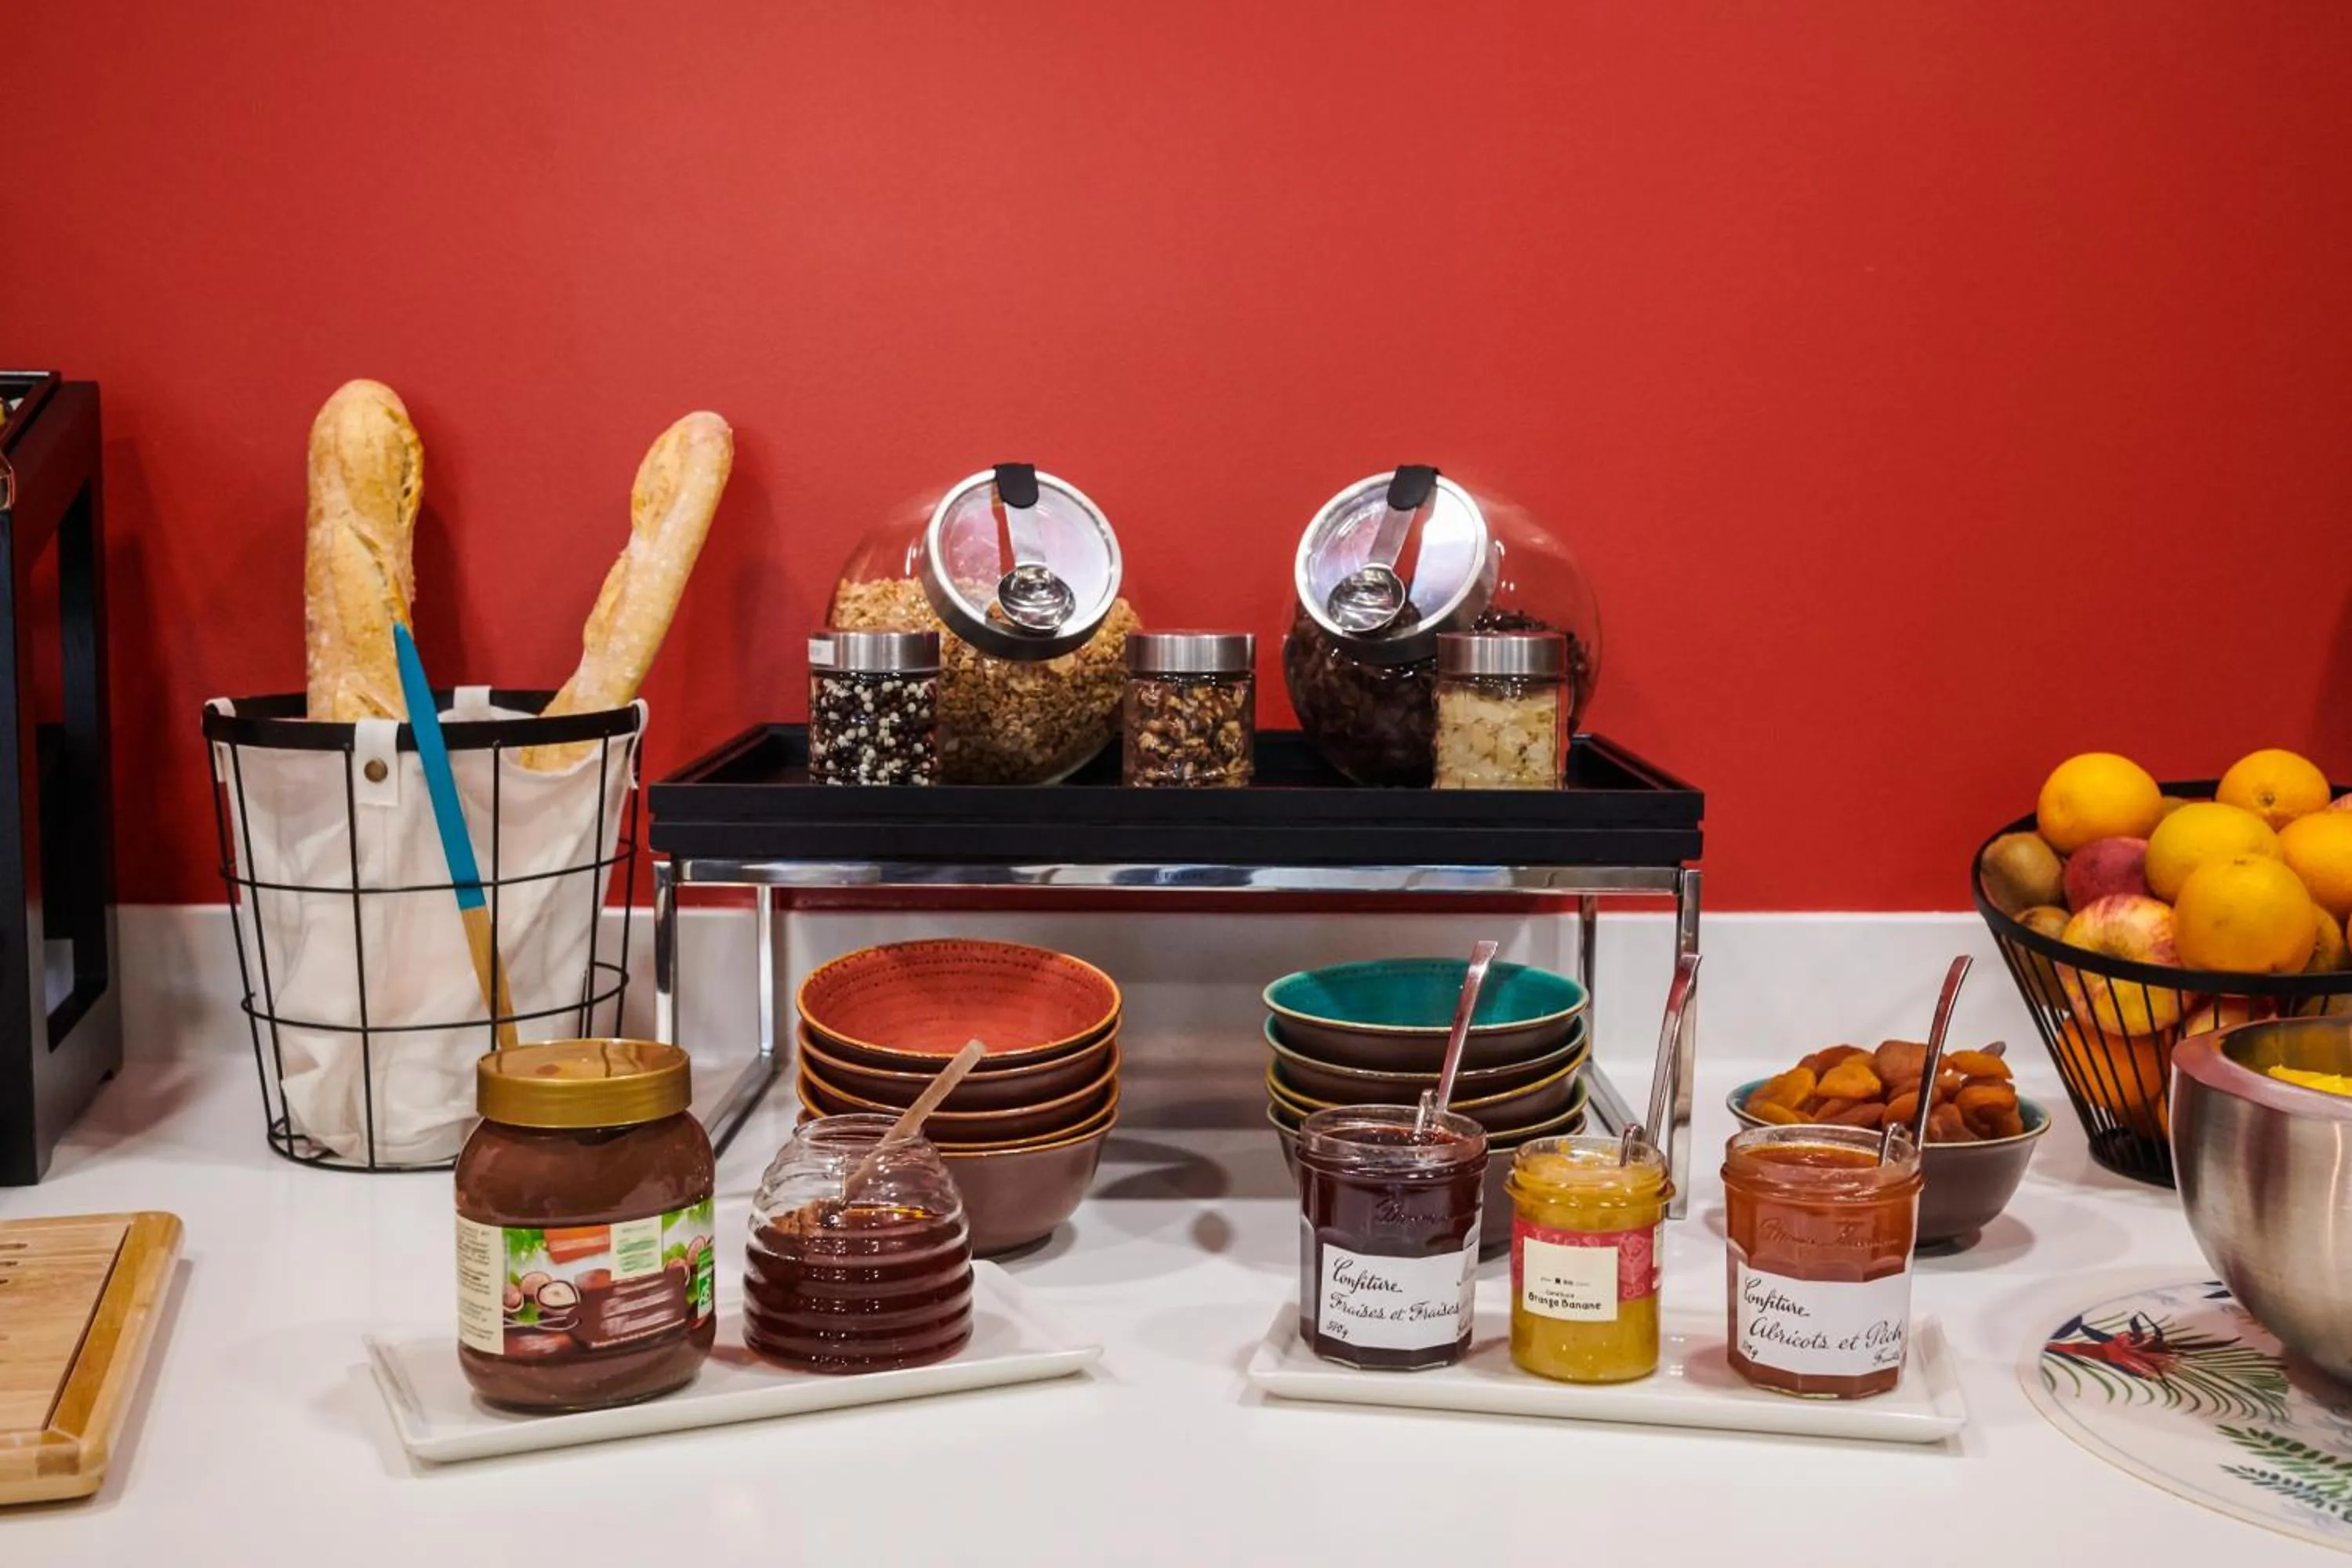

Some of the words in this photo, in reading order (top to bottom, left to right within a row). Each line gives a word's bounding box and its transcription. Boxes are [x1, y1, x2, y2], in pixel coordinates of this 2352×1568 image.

[1333, 1257, 1403, 1294] Confiture
[1330, 1291, 1385, 1319] Fraises
[1389, 1309, 1403, 1321] et
[1409, 1300, 1459, 1322] Fraises
[1561, 1298, 1602, 1310] Banane
[1744, 1276, 1810, 1317] Confiture
[1749, 1316, 1830, 1349] Abricots
[1838, 1334, 1860, 1351] et
